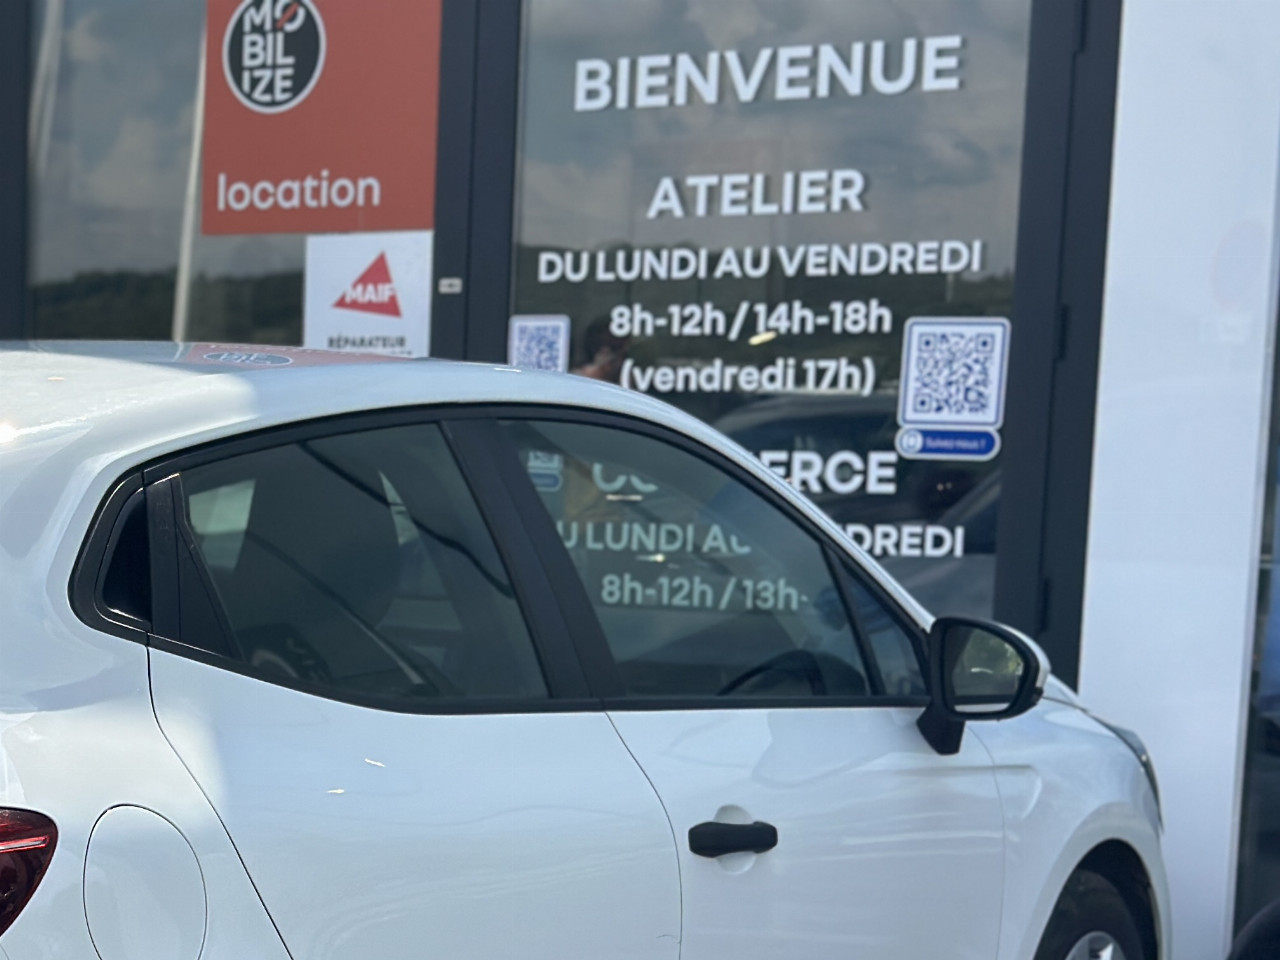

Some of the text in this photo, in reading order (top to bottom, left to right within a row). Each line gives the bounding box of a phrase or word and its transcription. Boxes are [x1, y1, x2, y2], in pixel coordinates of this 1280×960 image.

[573, 34, 963, 112] BIENVENUE
[217, 169, 381, 212] location
[646, 168, 867, 219] ATELIER
[537, 239, 982, 284] DU LUNDI AU VENDREDI
[620, 356, 876, 395] (vendredi 17h)
[586, 521, 695, 552] LUNDI
[837, 522, 966, 559] DREDI
